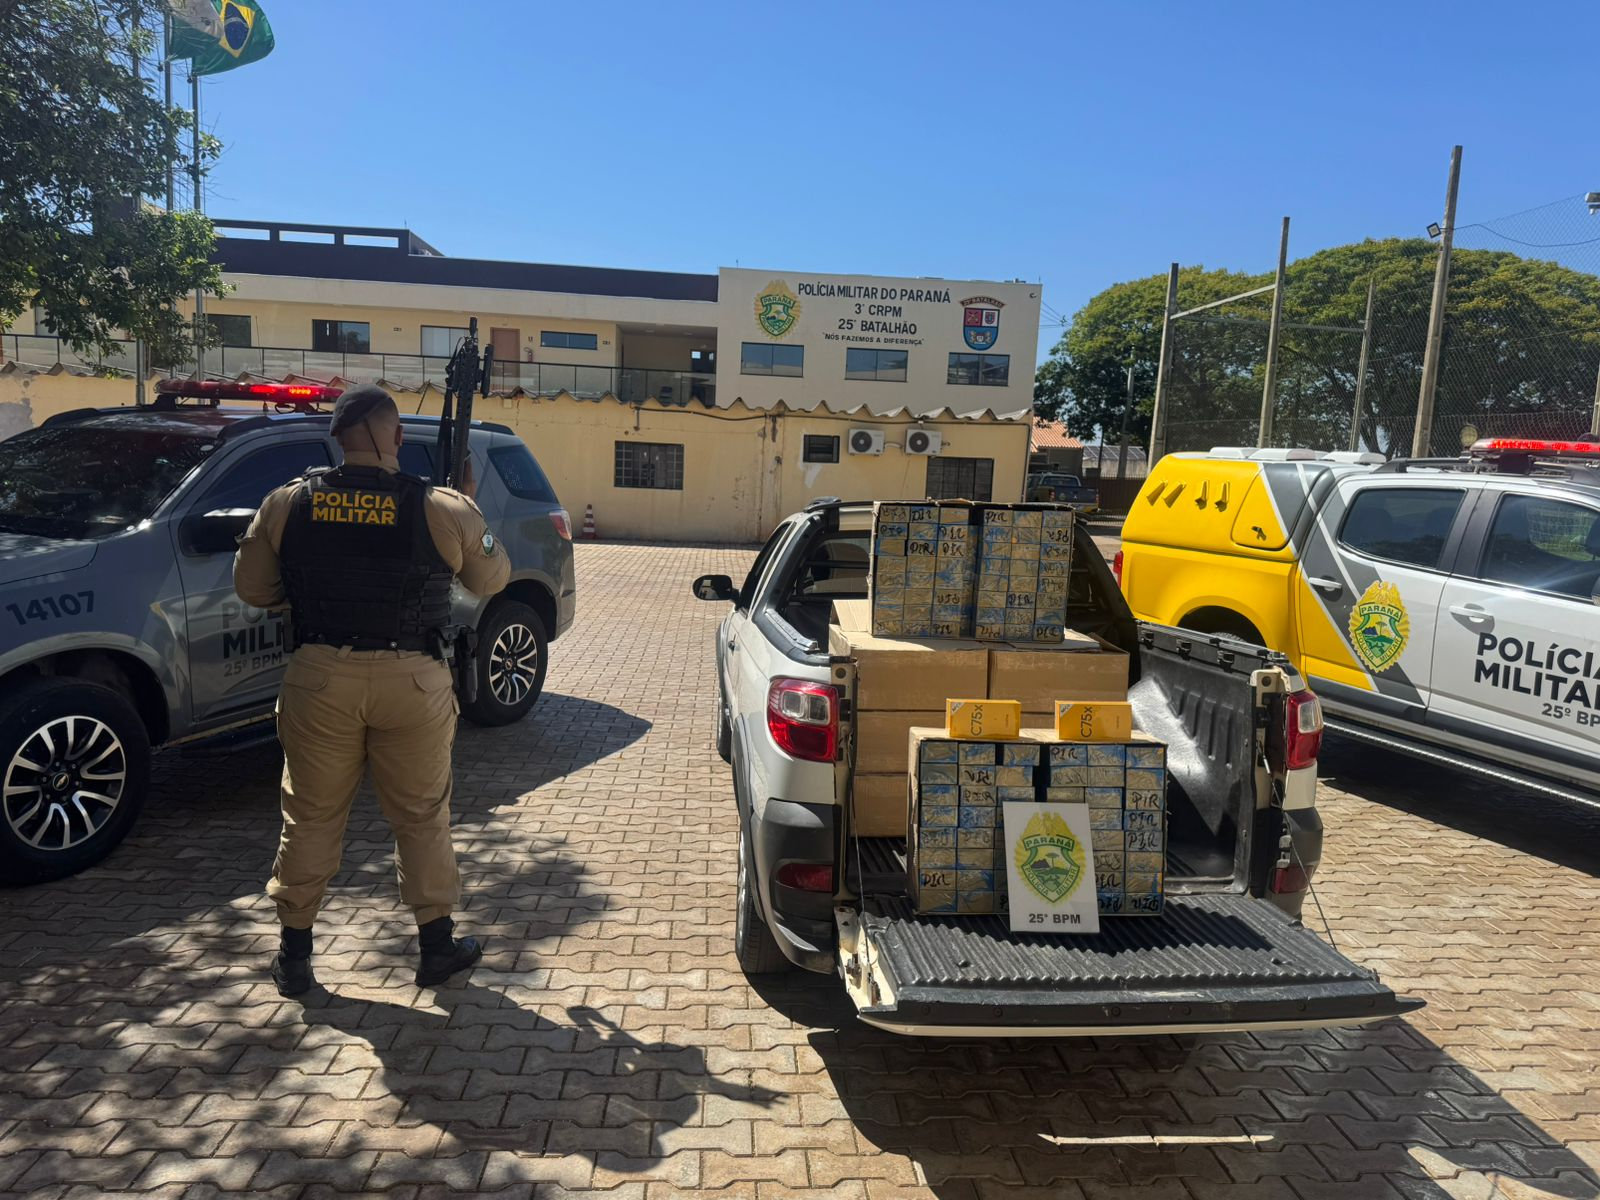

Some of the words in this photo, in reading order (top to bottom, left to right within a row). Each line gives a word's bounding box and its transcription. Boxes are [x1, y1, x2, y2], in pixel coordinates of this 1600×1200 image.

[798, 282, 835, 297] POLÍCIA
[837, 285, 878, 299] MILITAR
[880, 288, 897, 300] DO
[900, 288, 951, 303] PARANÁ
[868, 304, 902, 317] CRPM
[861, 320, 917, 335] BATALHÃO
[312, 490, 396, 509] POLÍCIA
[312, 507, 395, 524] MILITAR
[5, 590, 94, 625] 14107
[223, 621, 282, 659] MILI
[252, 651, 282, 670] BPM
[1477, 632, 1600, 680] POLÍCI
[1474, 659, 1600, 711] MILITA
[970, 704, 983, 736] C75x
[1080, 706, 1093, 738] C75x
[1576, 710, 1600, 727] BP
[1056, 868, 1077, 895] MILITAR
[1053, 914, 1081, 924] BPM
